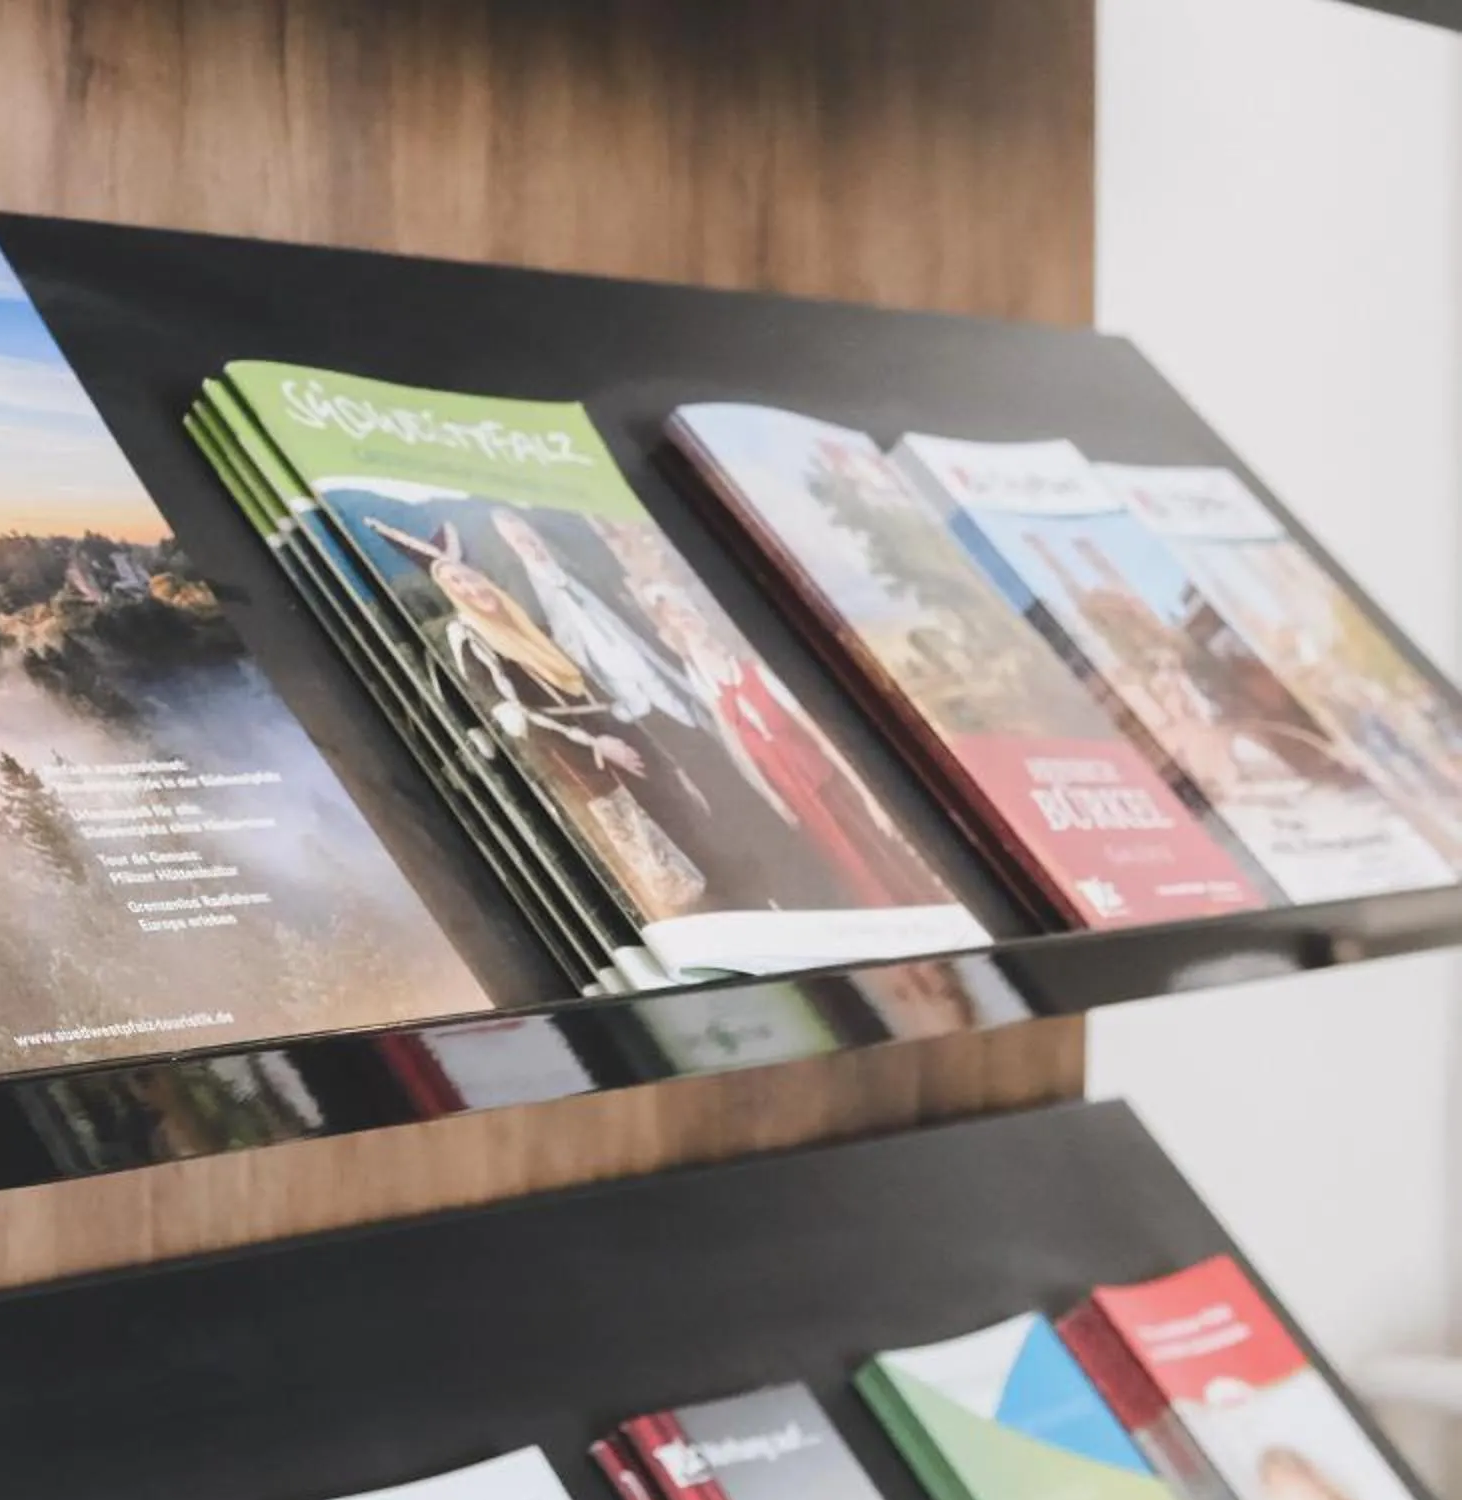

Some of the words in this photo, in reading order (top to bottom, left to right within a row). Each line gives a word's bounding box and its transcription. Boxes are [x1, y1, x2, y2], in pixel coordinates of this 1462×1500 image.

[96, 853, 129, 868] Tour
[132, 851, 150, 866] de
[127, 897, 202, 913] Grenzenlos
[138, 916, 187, 933] Europa
[188, 912, 237, 928] erleben
